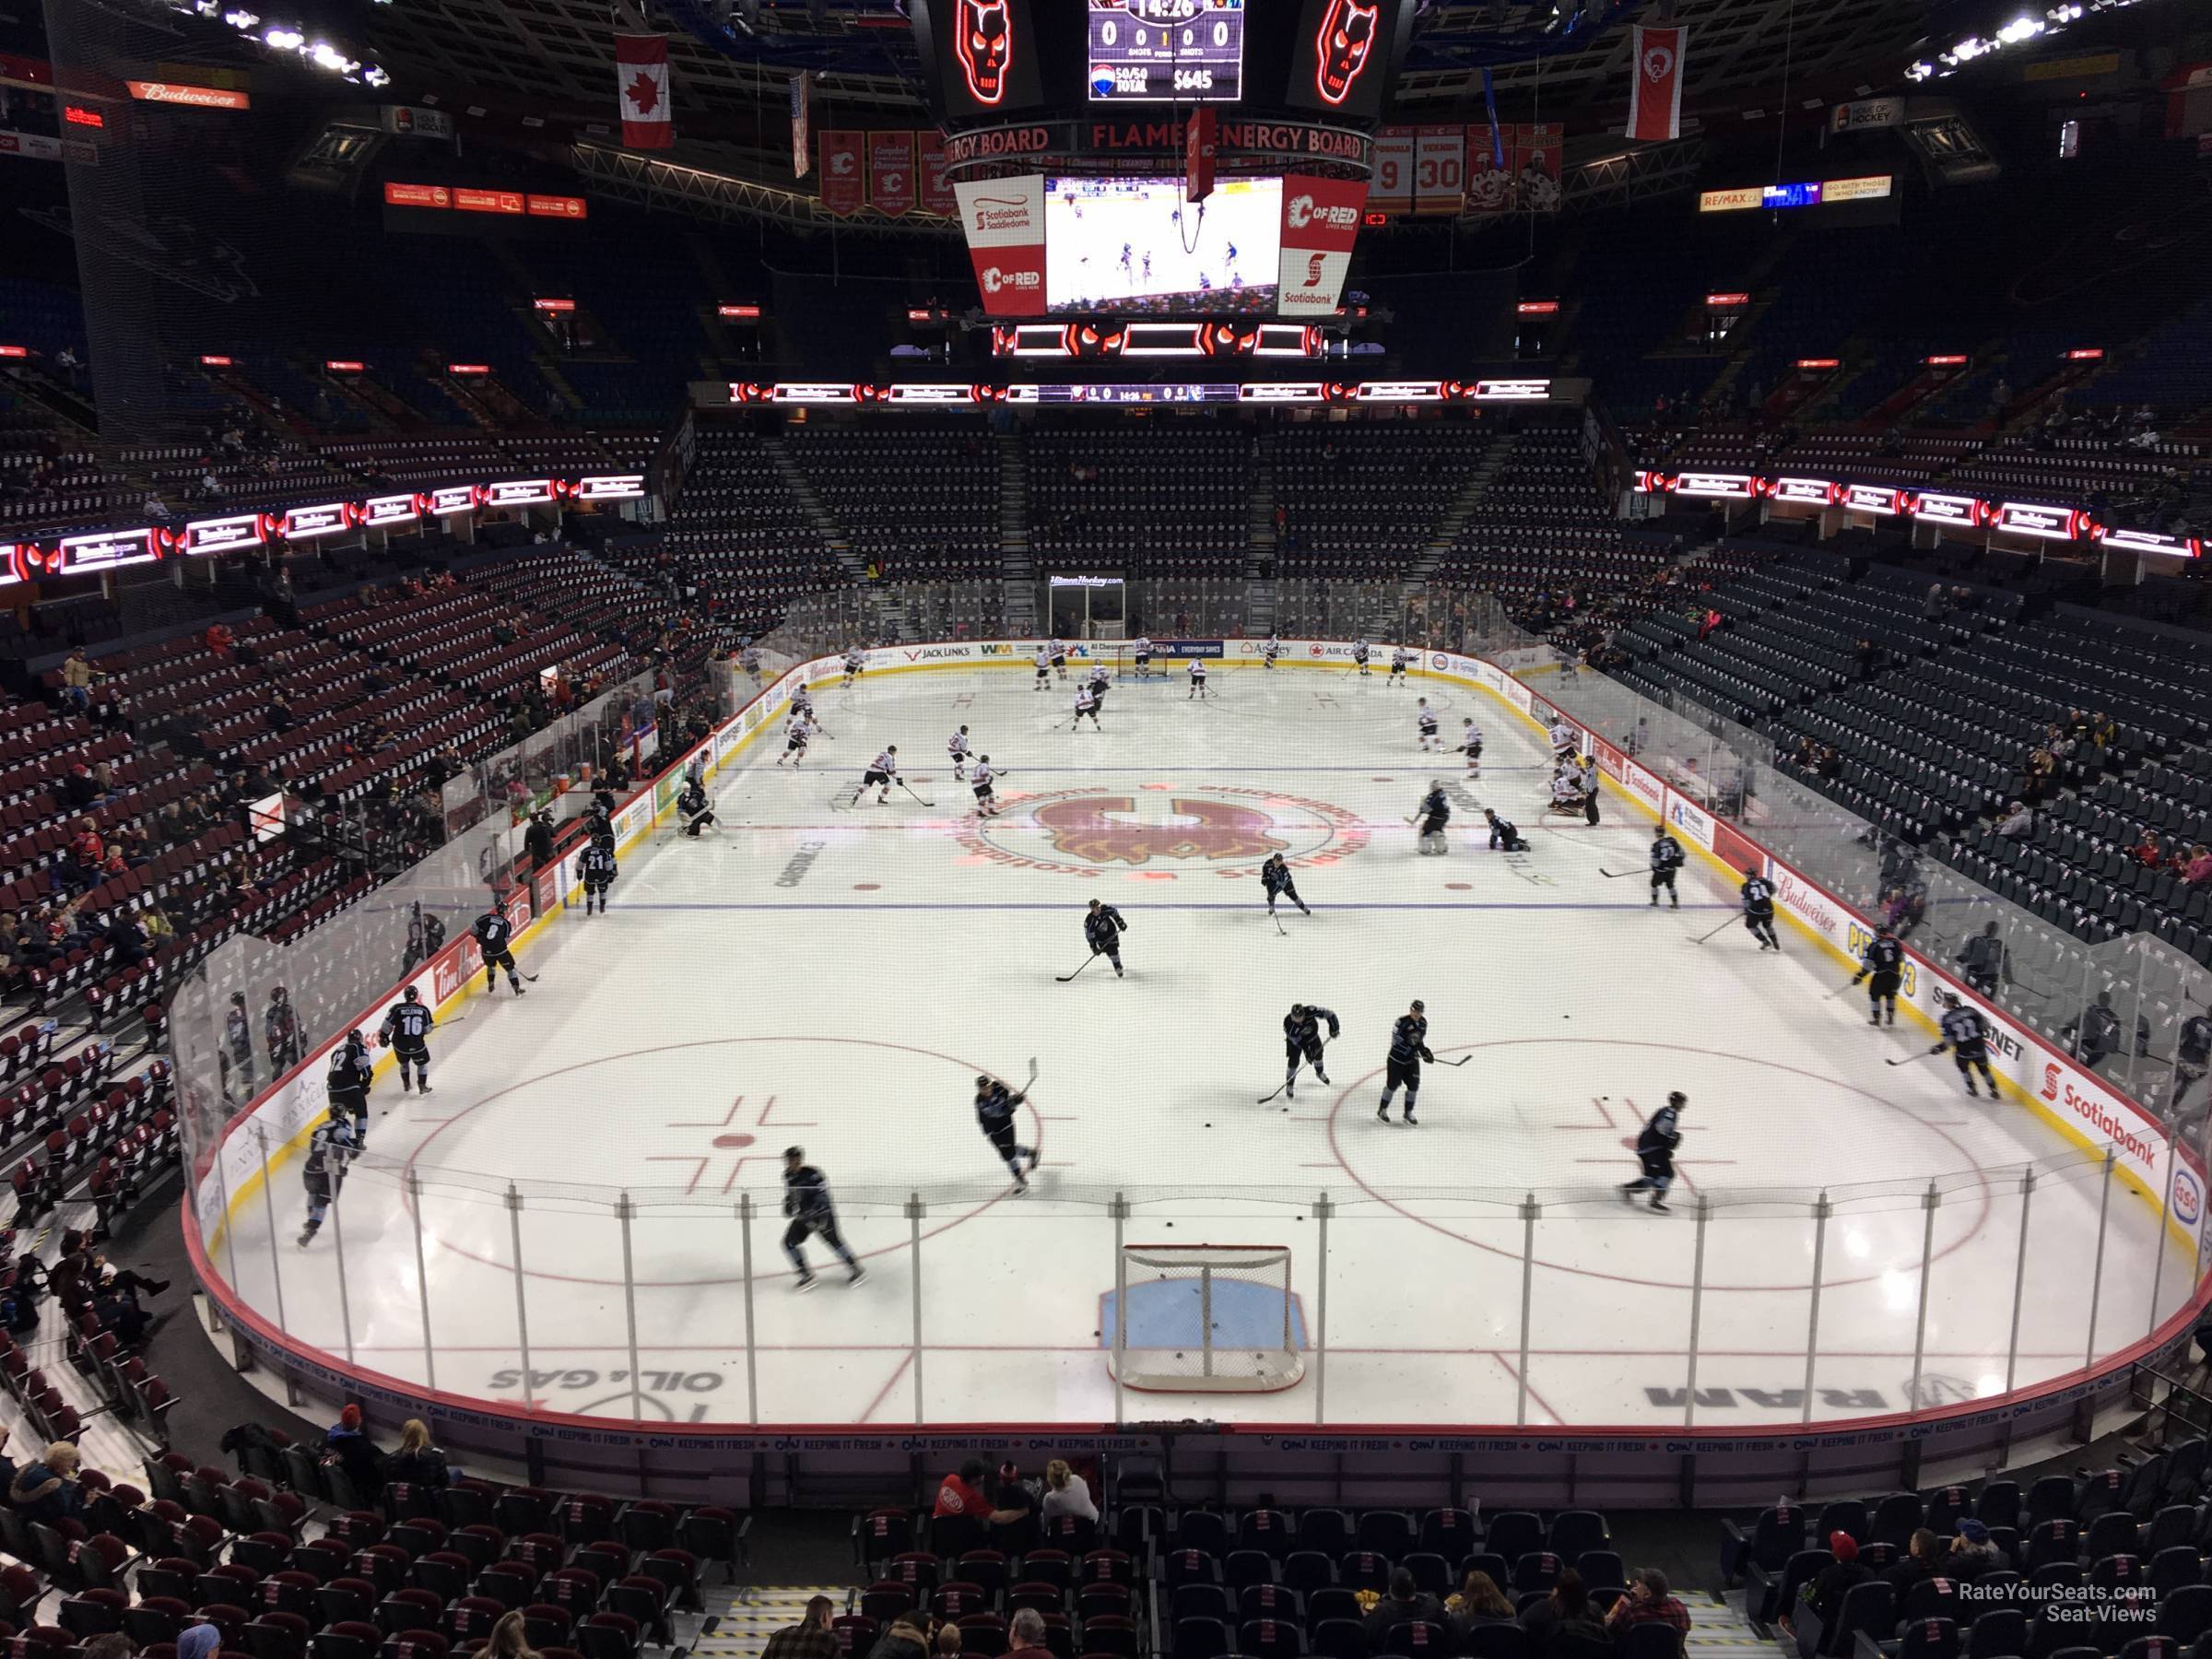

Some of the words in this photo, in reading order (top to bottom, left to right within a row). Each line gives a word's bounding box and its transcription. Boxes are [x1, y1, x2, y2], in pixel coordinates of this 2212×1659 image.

[1101, 20, 1117, 45] 0
[1135, 29, 1147, 46] 0
[1182, 29, 1194, 46] 0
[1213, 21, 1229, 46] 0
[1128, 48, 1152, 56] SHOTS
[1116, 67, 1148, 80] 50/50
[1174, 70, 1213, 90] $645
[1117, 79, 1147, 92] TOTAL
[140, 82, 235, 106] Budweiser
[1853, 112, 1890, 124] HOCKEY
[981, 128, 1049, 156] BOARD
[1308, 129, 1361, 158] BOARD
[1380, 161, 1399, 190] 9
[1418, 158, 1460, 189] 30
[986, 207, 1030, 220] Scotiabank
[1312, 206, 1328, 218] OF
[1327, 206, 1359, 224] RED
[987, 218, 1030, 229] Saddledome
[1003, 274, 1015, 285] OF
[1016, 271, 1040, 286] RED
[1284, 291, 1332, 305] Scotiabank
[1102, 387, 1112, 399] 0
[1164, 387, 1171, 399] 0
[1049, 576, 1124, 587] HitmenHockey.com
[923, 649, 944, 659] JACK
[1325, 647, 1342, 655] AIR
[588, 856, 604, 870] 21
[1778, 870, 1837, 932] Budweiser
[486, 924, 499, 940] 8
[402, 1016, 423, 1036] 16
[2065, 1083, 2156, 1171] Scotiabank
[487, 1370, 601, 1390] GAS
[609, 1370, 629, 1382] &
[640, 1371, 724, 1394] OIL
[1643, 1387, 1889, 1409] RAM
